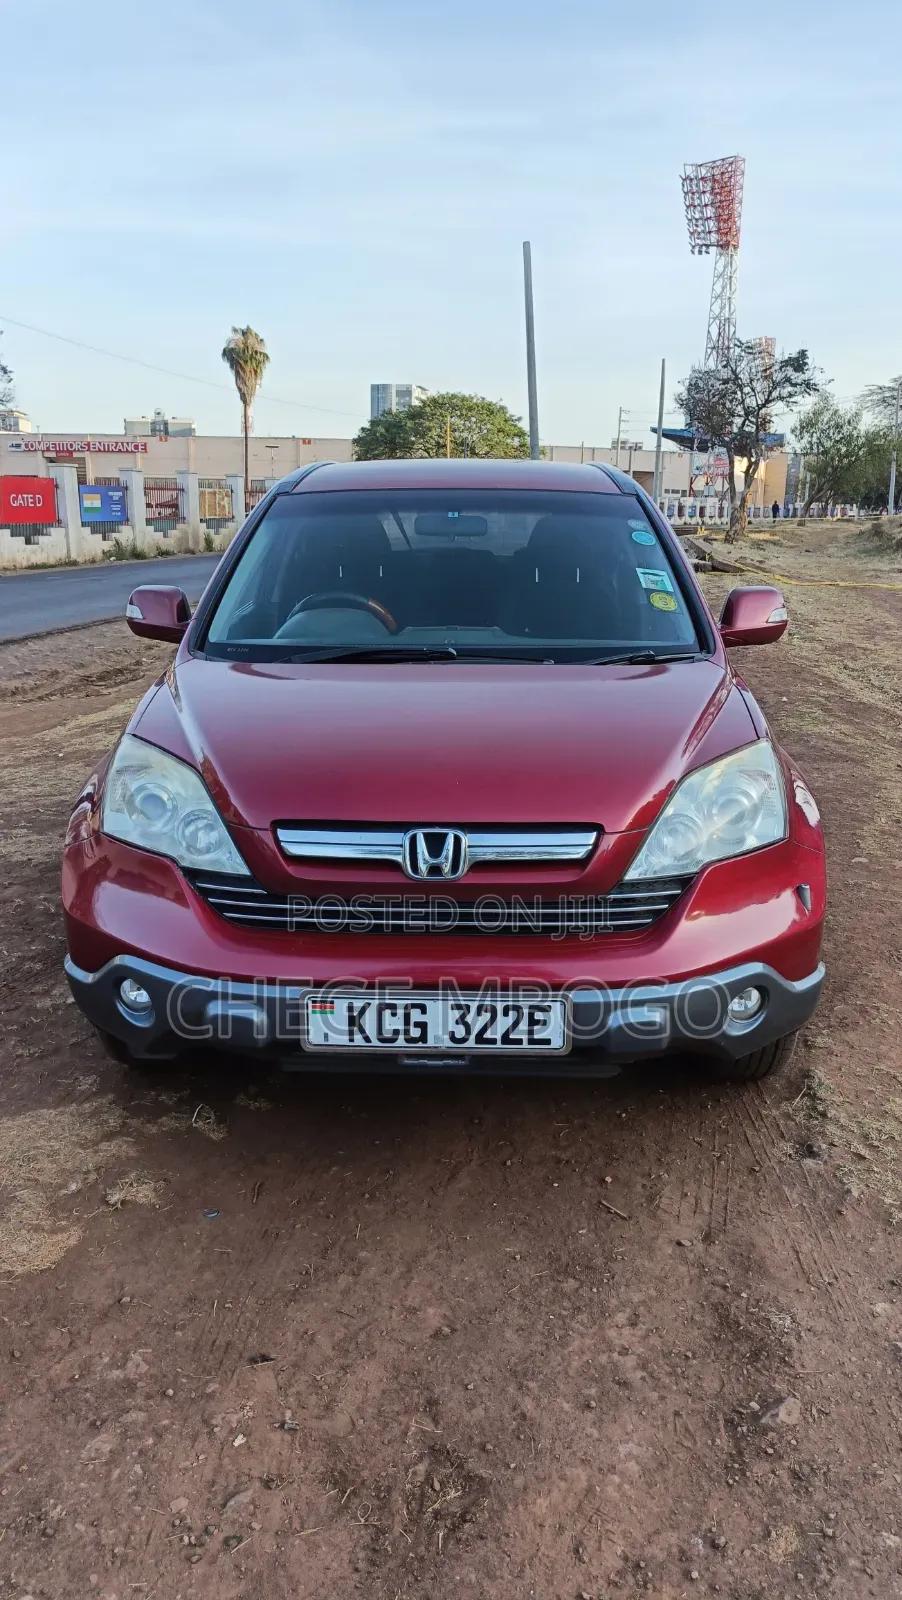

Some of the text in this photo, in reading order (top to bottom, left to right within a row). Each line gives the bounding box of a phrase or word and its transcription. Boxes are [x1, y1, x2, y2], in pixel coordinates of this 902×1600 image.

[23, 441, 88, 451] COMPETITORS
[90, 441, 146, 452] ENTRANCE
[10, 494, 43, 507] GATE D
[347, 1001, 428, 1044] KCG
[449, 1003, 552, 1046] 322E
